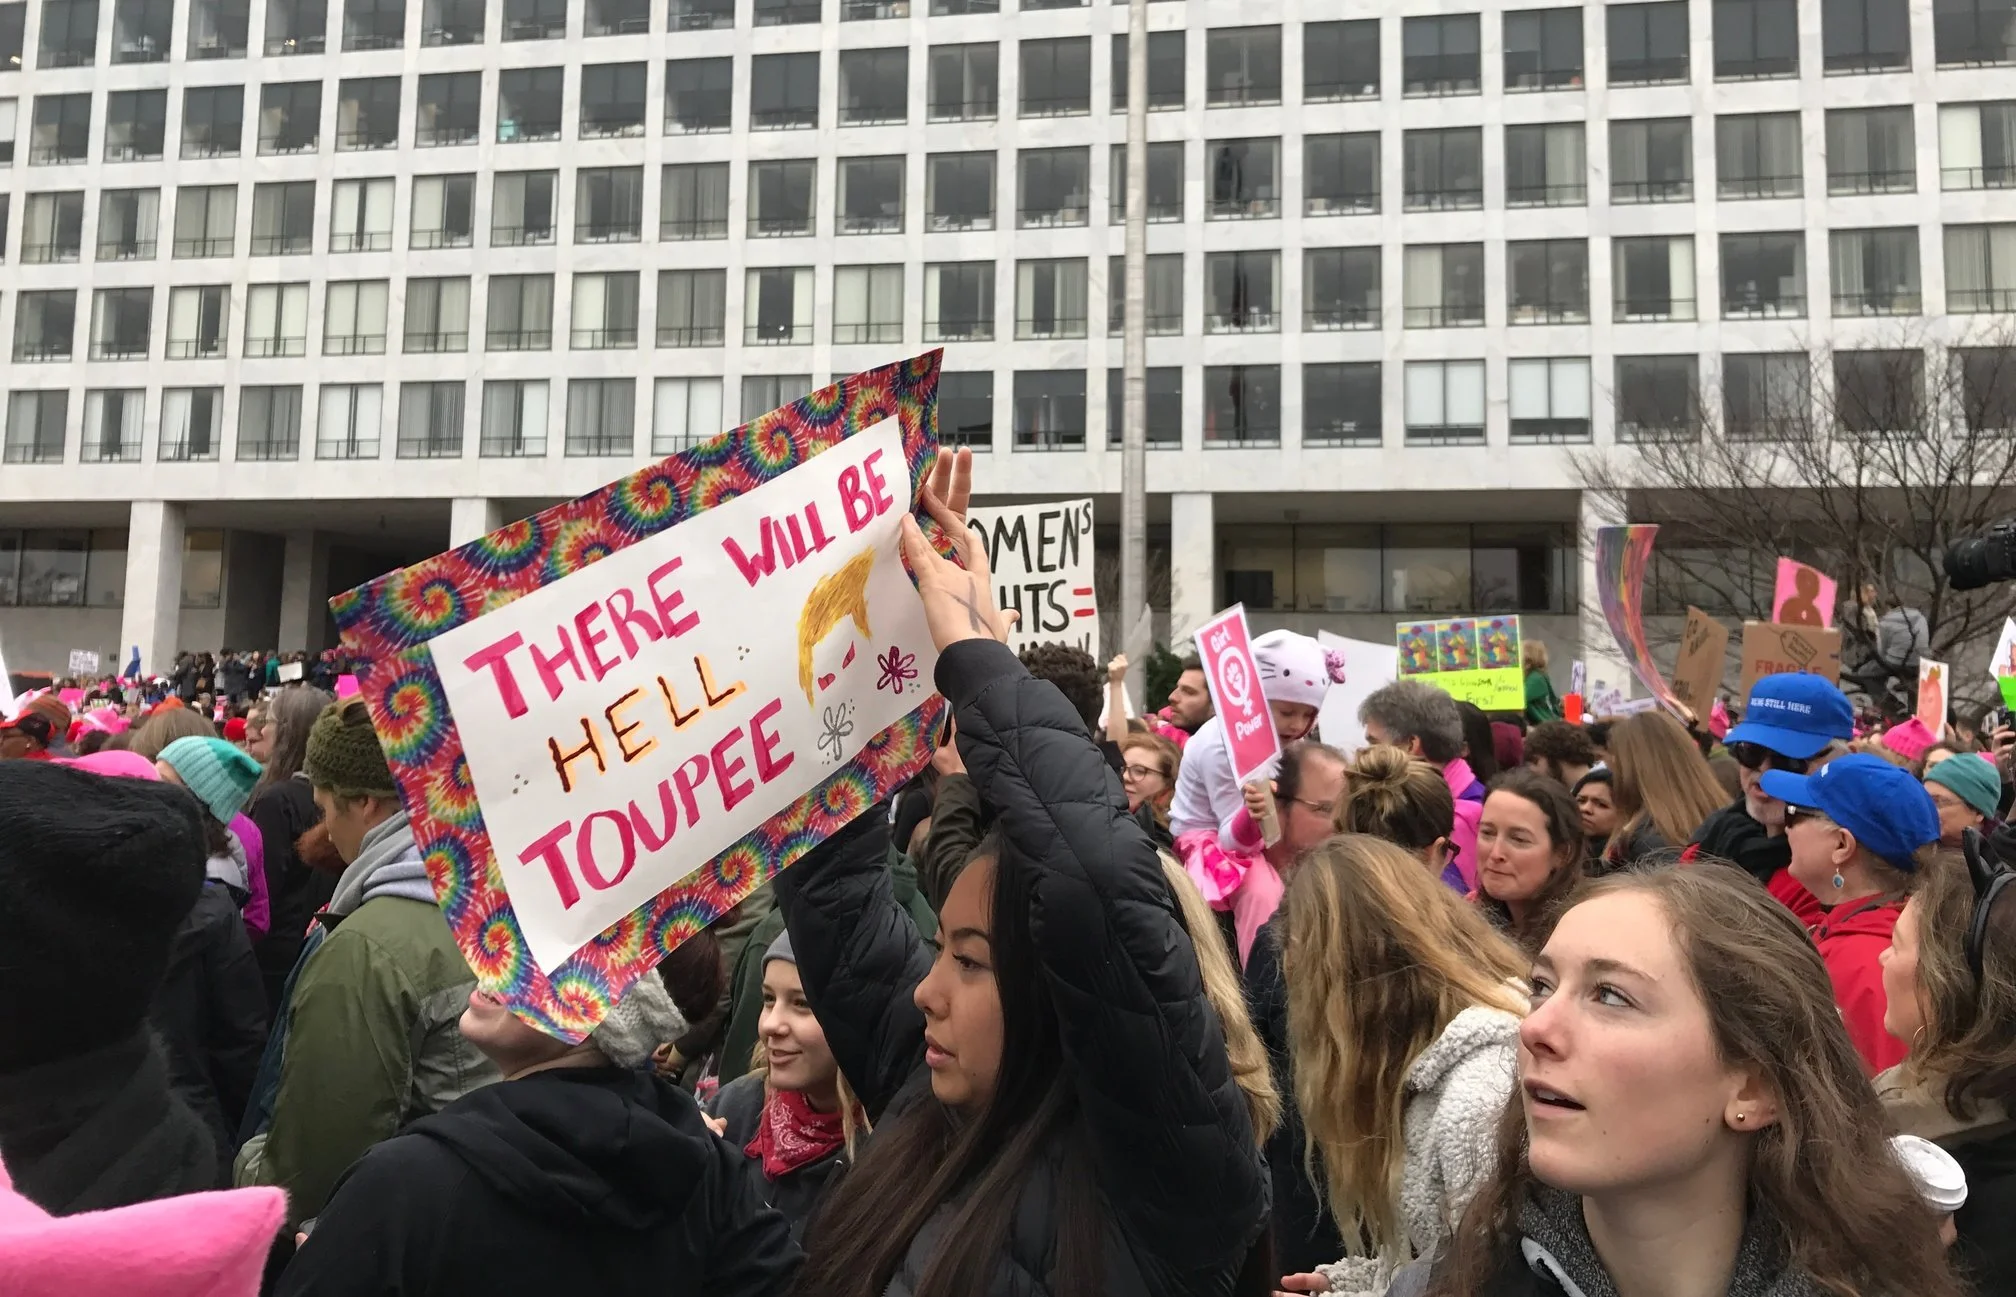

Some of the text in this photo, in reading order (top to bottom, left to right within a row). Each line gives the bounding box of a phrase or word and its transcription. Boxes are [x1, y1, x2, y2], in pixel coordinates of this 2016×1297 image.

[463, 448, 894, 720] THERE WILL BE
[1210, 624, 1232, 653] Girl
[548, 653, 747, 793] HELL
[1235, 713, 1263, 741] Power
[516, 697, 795, 910] TOUPEE
